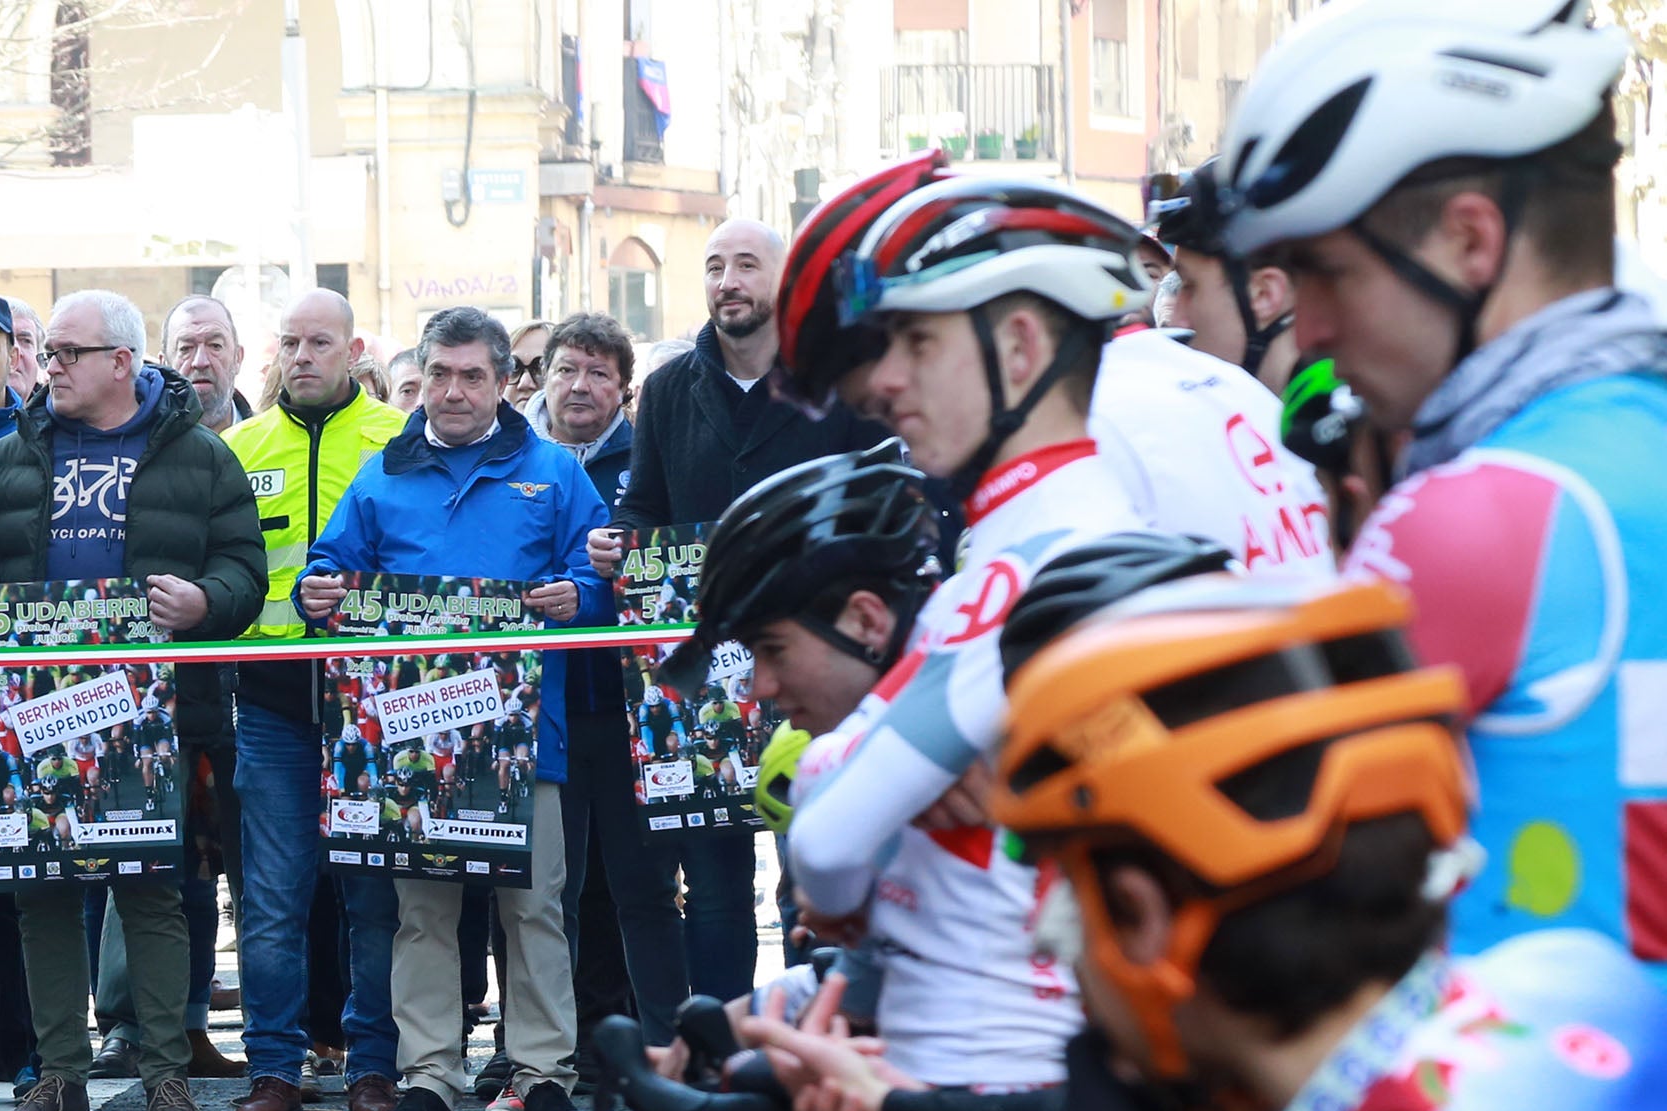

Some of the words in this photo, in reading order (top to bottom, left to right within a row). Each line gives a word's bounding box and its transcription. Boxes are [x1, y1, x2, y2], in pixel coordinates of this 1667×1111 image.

[623, 547, 665, 582] 45
[16, 597, 148, 623] UDABERRI
[339, 589, 382, 622] 45
[388, 592, 521, 619] UDABERRI
[642, 594, 657, 619] 5
[33, 633, 77, 644] JUNIOR
[16, 698, 69, 726] BERTAN
[72, 679, 125, 709] BEHERA
[382, 692, 435, 716] BERTAN
[440, 677, 493, 703] BEHERA
[23, 698, 130, 745] SUSPENDIDO
[387, 696, 497, 735] SUSPENDIDO
[98, 824, 174, 837] PNEUMAX
[448, 826, 525, 840] PNEUMAX
